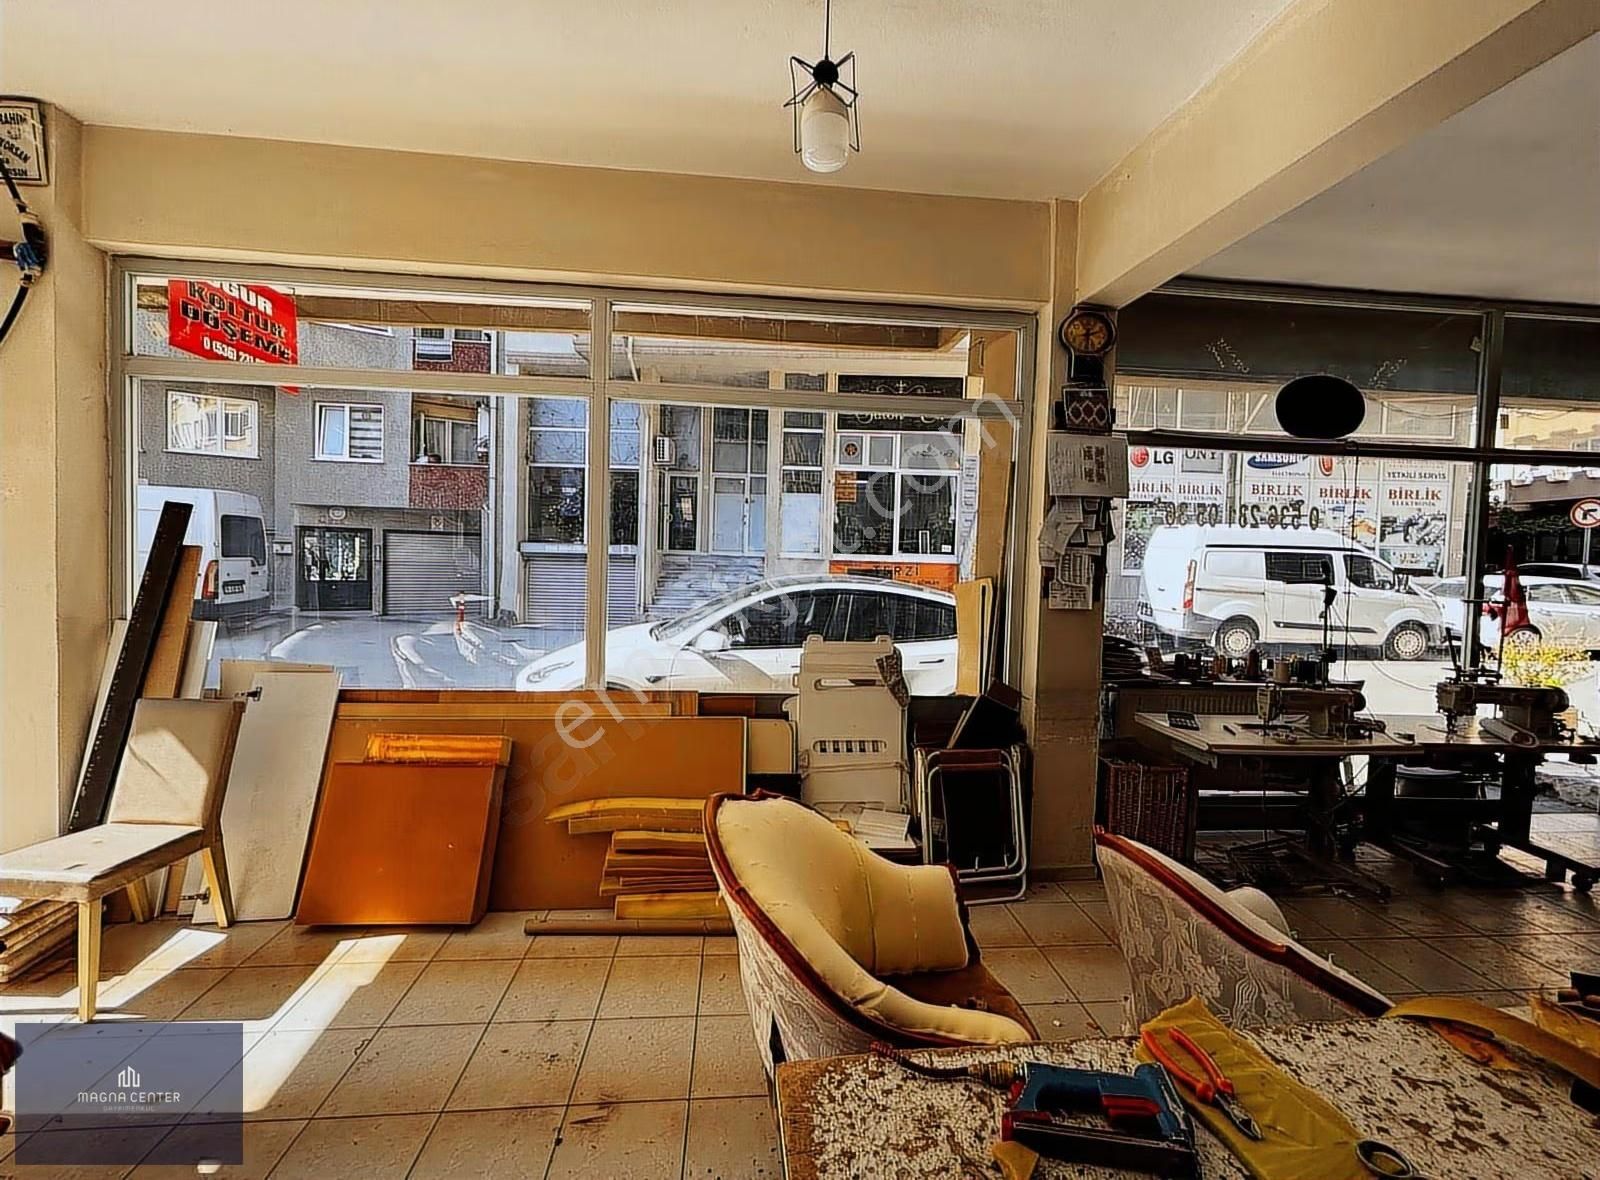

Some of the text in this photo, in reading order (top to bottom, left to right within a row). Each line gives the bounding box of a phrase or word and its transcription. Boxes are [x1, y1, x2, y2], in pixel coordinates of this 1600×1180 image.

[187, 281, 287, 339] KOLTUK
[203, 336, 211, 350] 0
[1153, 450, 1174, 465] LG
[1179, 482, 1223, 495] BİRLİK
[1251, 482, 1304, 496] BİRLİK
[1319, 485, 1372, 499] BİRLİK
[1388, 487, 1442, 500] BİRLİK
